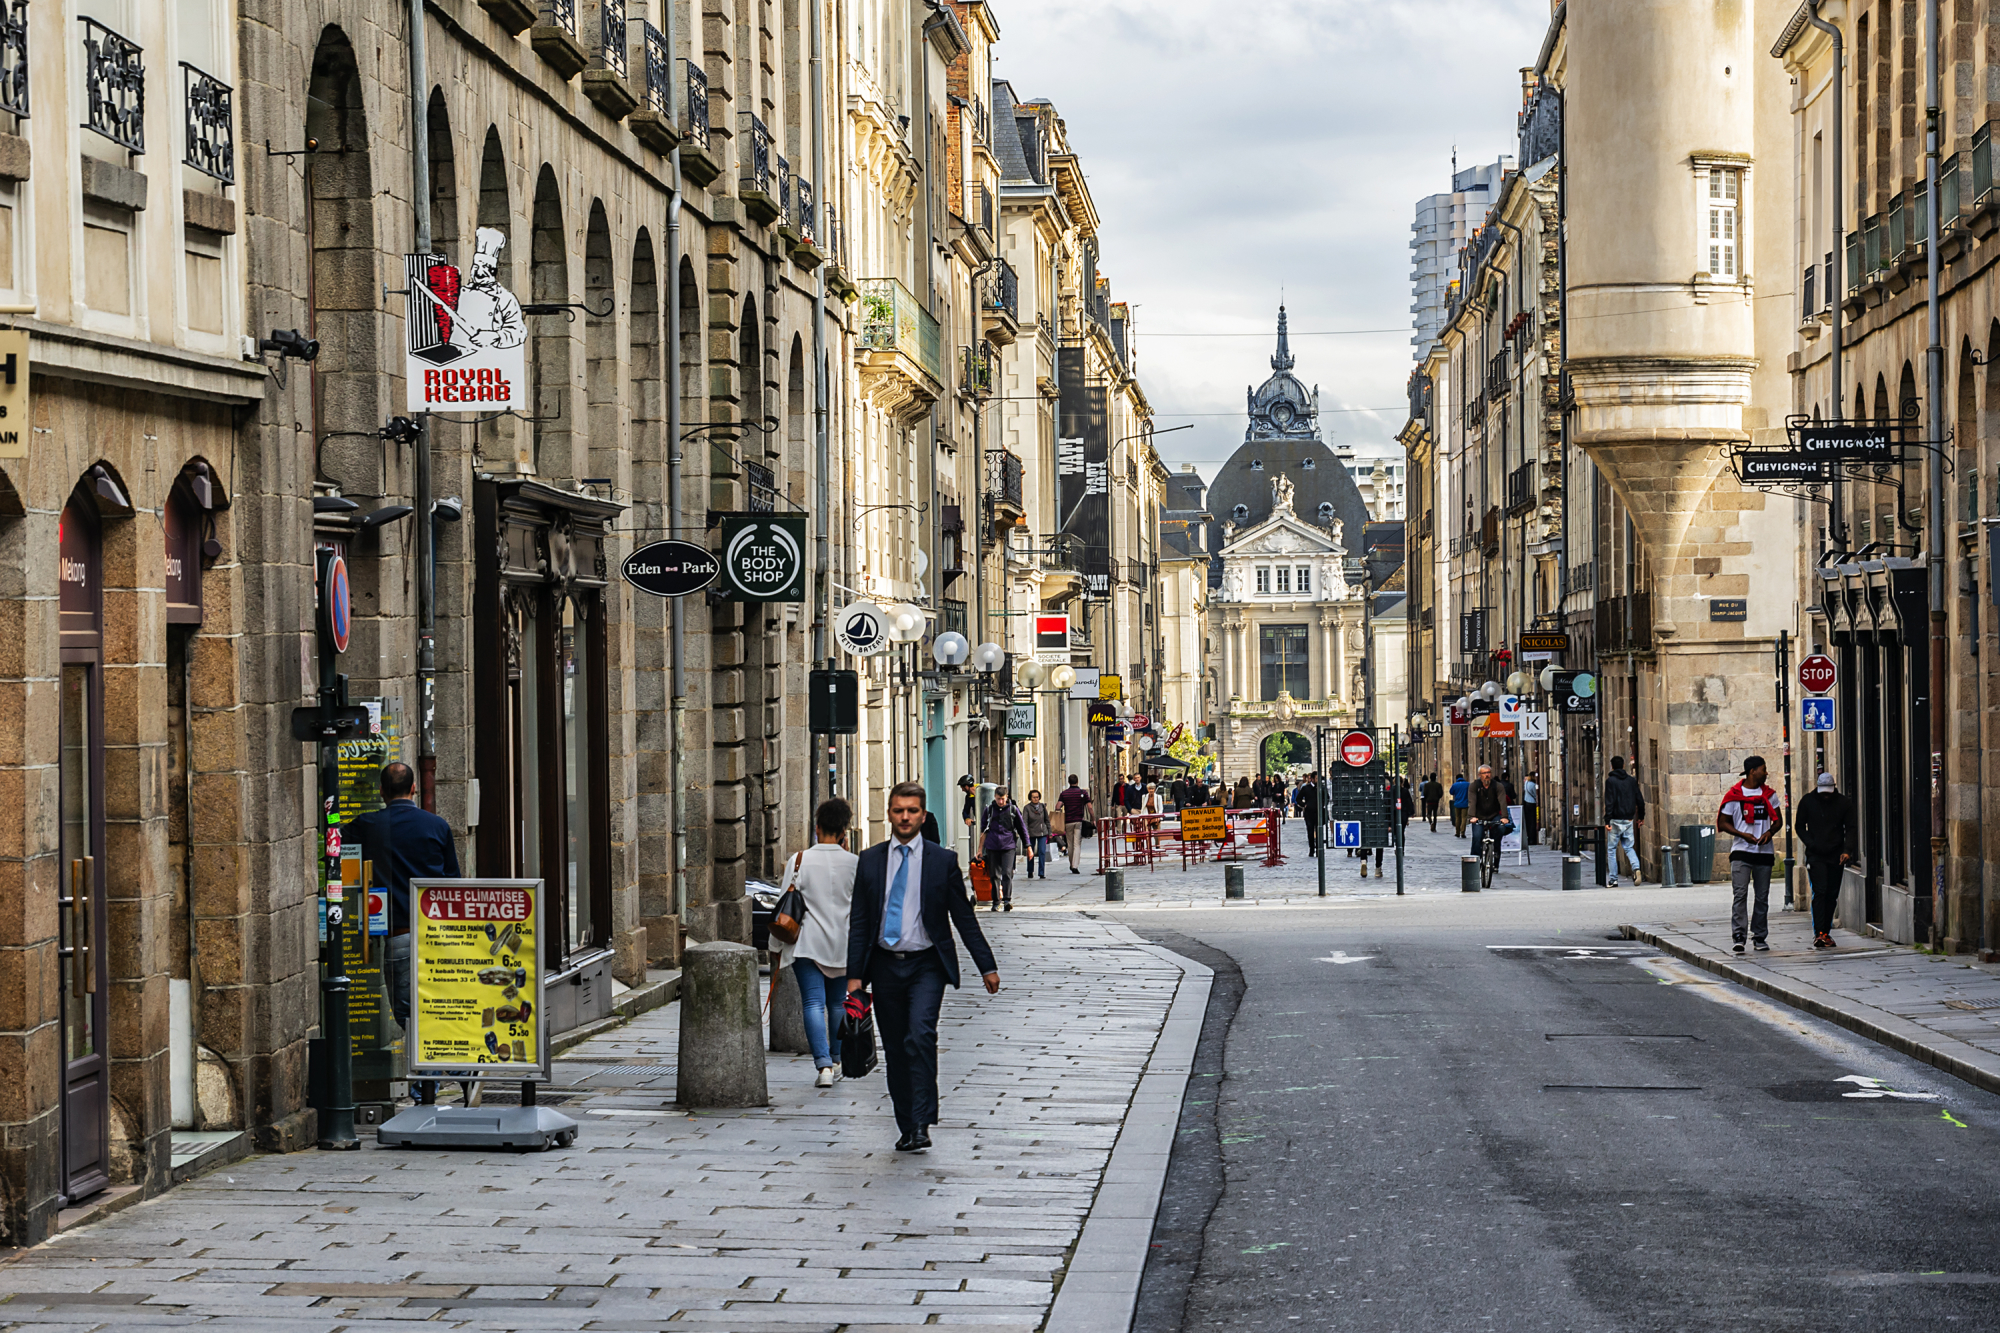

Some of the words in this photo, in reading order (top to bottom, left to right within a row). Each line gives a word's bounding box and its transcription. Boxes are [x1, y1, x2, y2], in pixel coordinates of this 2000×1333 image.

[424, 368, 511, 387] ROYAL
[424, 385, 511, 404] KEBAB
[1806, 437, 1885, 450] CHEVIGNON
[1747, 461, 1817, 473] CHEVIGNON
[750, 546, 776, 556] THE
[628, 563, 661, 575] Eden
[682, 562, 715, 574] Park
[741, 558, 787, 570] BODY
[744, 571, 784, 582] SHOP
[839, 633, 856, 651] PETIT
[858, 635, 884, 653] BATEAU
[1524, 638, 1564, 647] NICOLAS
[1802, 668, 1833, 681] STOP
[1013, 708, 1028, 719] Yves
[1090, 713, 1115, 723] Mim
[1008, 718, 1033, 730] Rocher
[1491, 728, 1513, 736] orange
[429, 890, 462, 902] SALLE
[428, 902, 442, 918] A
[447, 903, 459, 918] L
[464, 902, 526, 919] ETAGE
